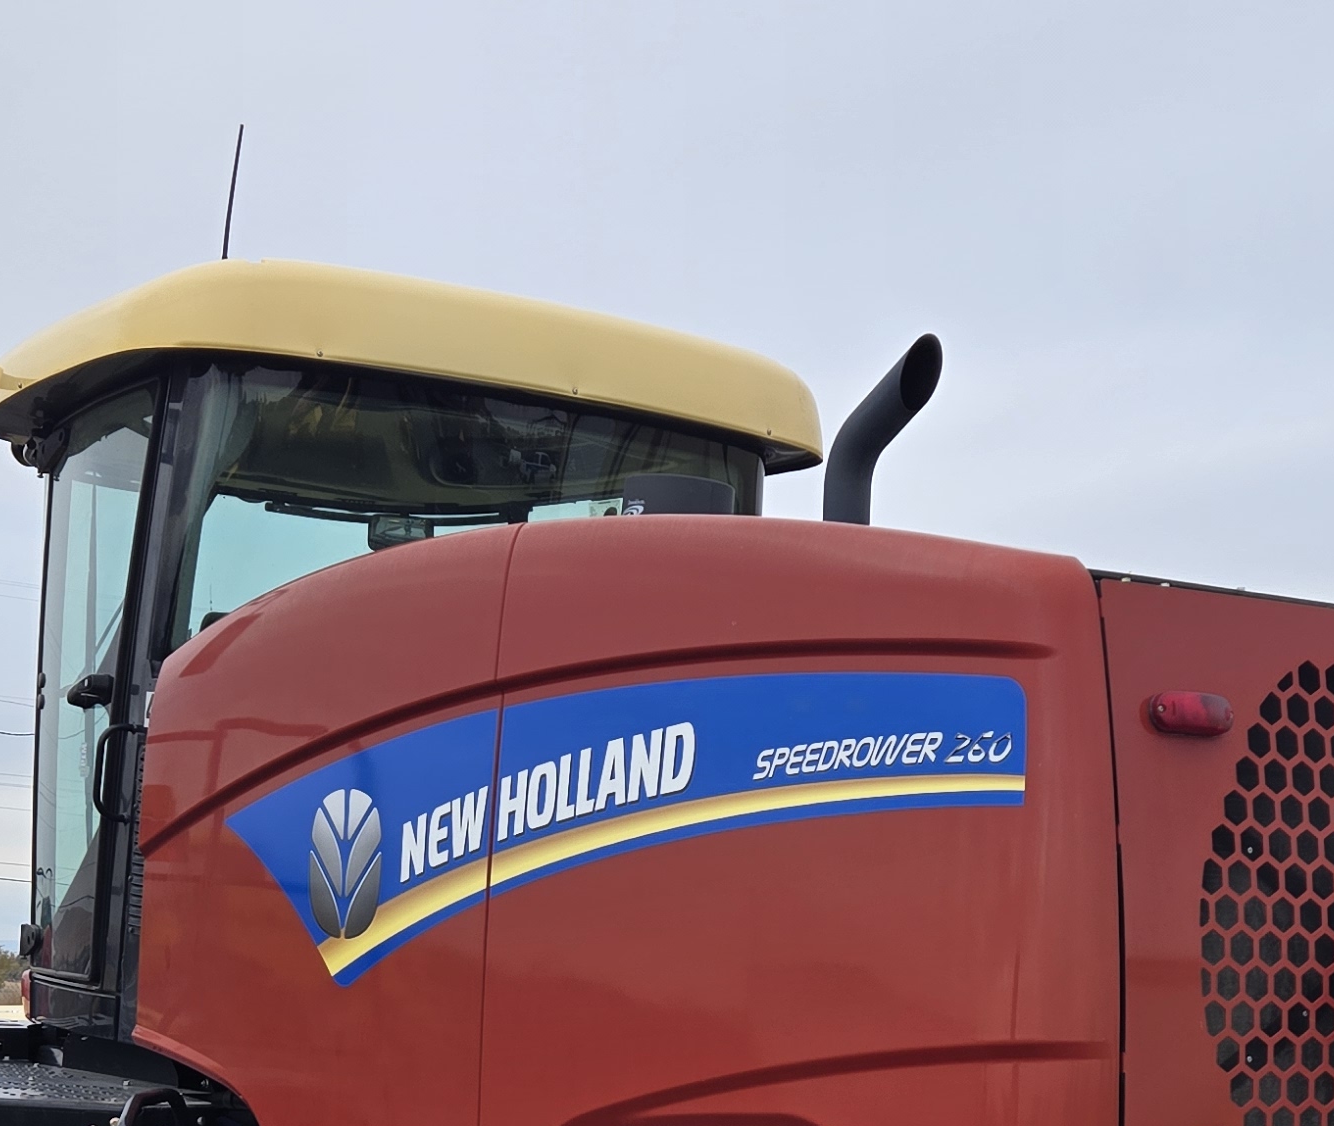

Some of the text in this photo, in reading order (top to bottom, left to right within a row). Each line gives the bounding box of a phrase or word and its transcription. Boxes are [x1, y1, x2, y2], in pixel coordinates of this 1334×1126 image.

[400, 721, 695, 883] NEW HOLLAND
[752, 730, 1012, 780] SPEEDROWER 260
